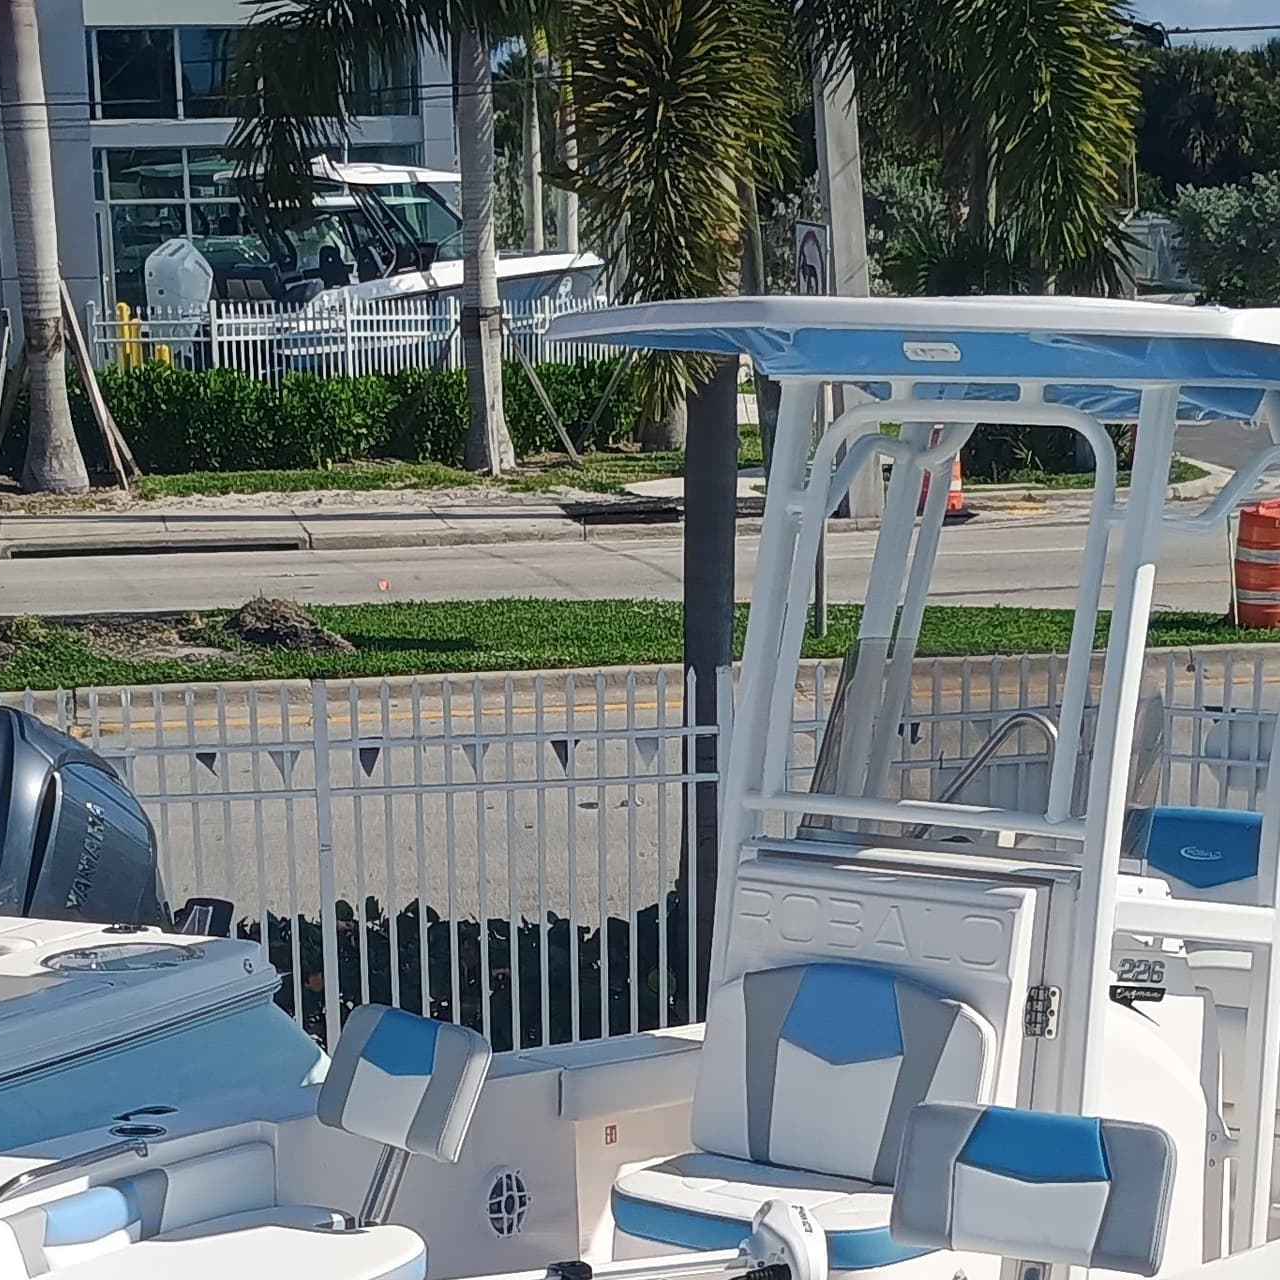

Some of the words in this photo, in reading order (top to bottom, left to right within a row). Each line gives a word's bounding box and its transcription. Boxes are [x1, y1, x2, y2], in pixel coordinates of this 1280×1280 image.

[64, 801, 106, 910] YAMAHA
[738, 887, 1004, 967] ROBALO
[1116, 958, 1166, 984] 226
